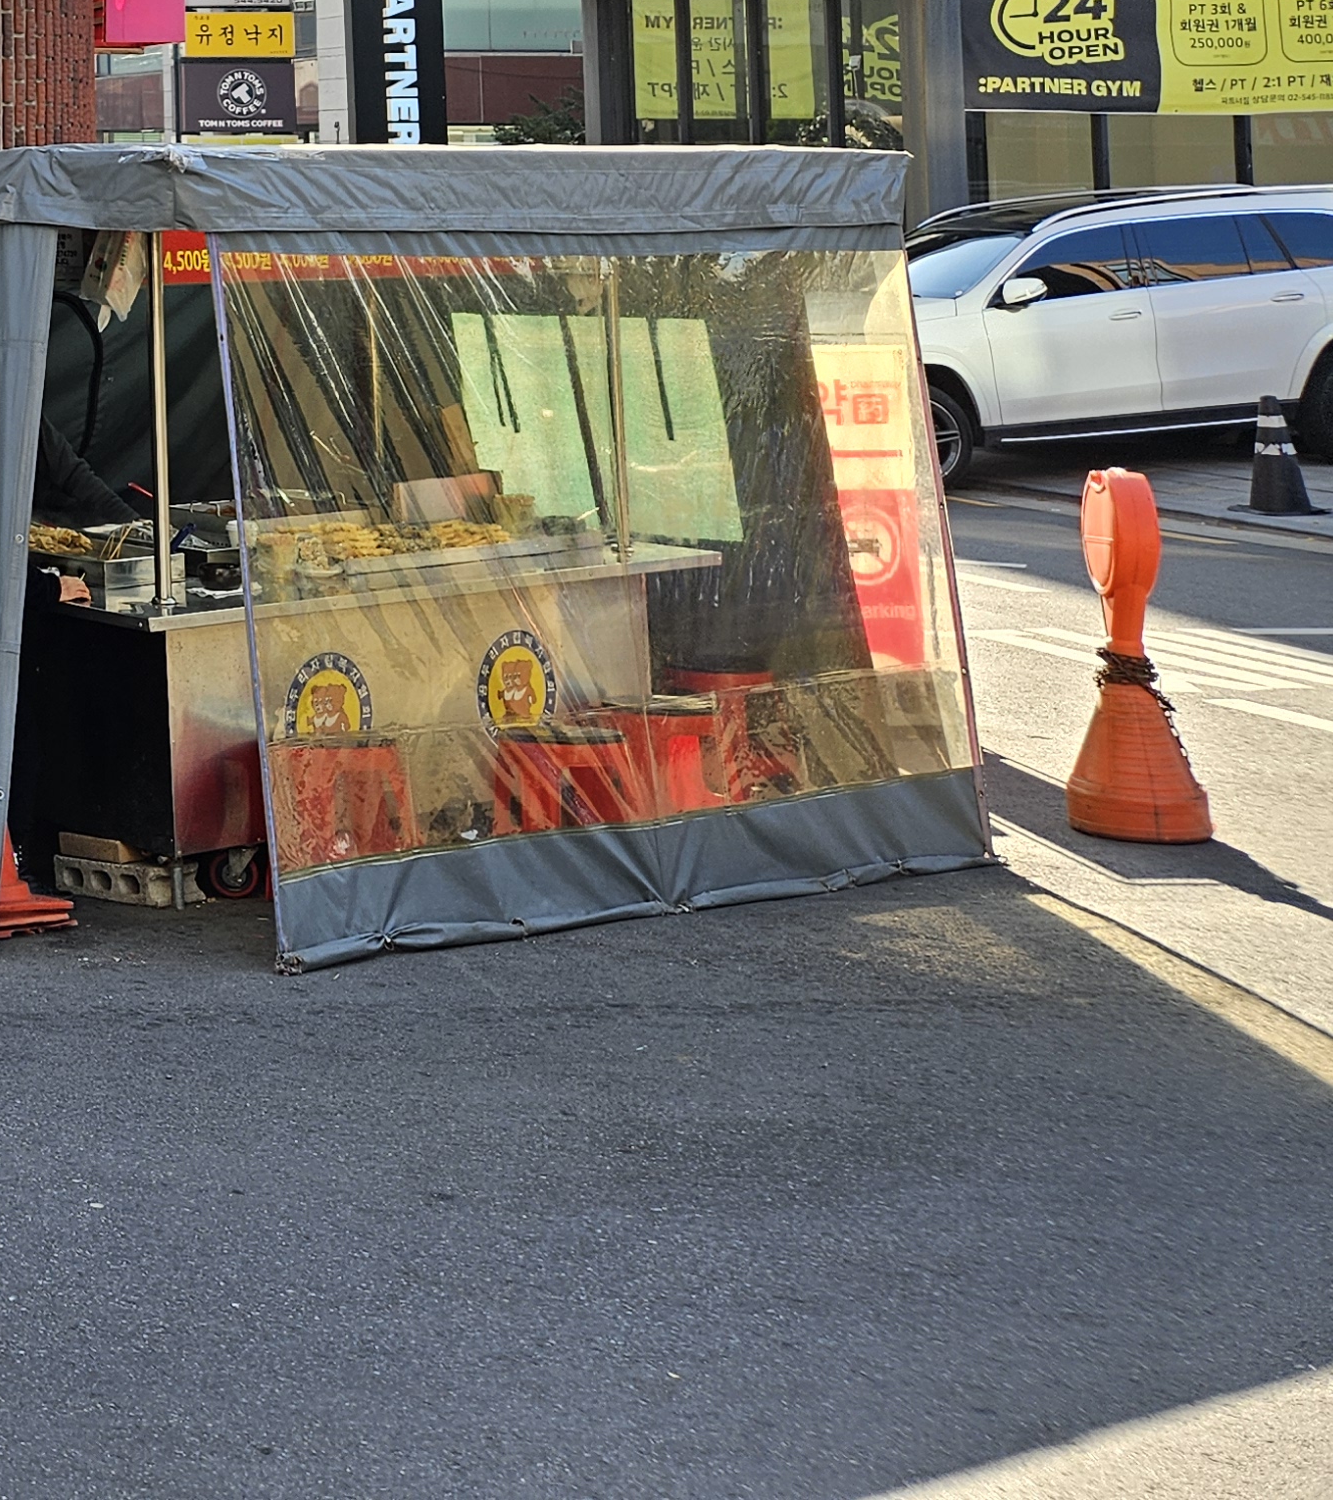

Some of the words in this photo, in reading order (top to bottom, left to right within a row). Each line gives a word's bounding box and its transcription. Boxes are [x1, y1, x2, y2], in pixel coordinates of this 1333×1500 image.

[1189, 3, 1206, 15] PT
[1210, 2, 1232, 16] 3회
[1237, 2, 1247, 14] &
[1296, 0, 1315, 11] PT
[1180, 18, 1220, 33] 회원권
[1224, 17, 1258, 32] 1개월
[1289, 15, 1328, 29] 회원권
[1037, 27, 1111, 45] HOUR
[1048, 42, 1120, 61] OPEN
[1090, 80, 1142, 97] GYM
[1192, 77, 1217, 92] 헬스
[1230, 79, 1247, 90] PT
[1262, 76, 1282, 88] 2:1
[1287, 75, 1306, 87] PT
[222, 98, 263, 115] COFFEE
[251, 119, 284, 128] COFFEE
